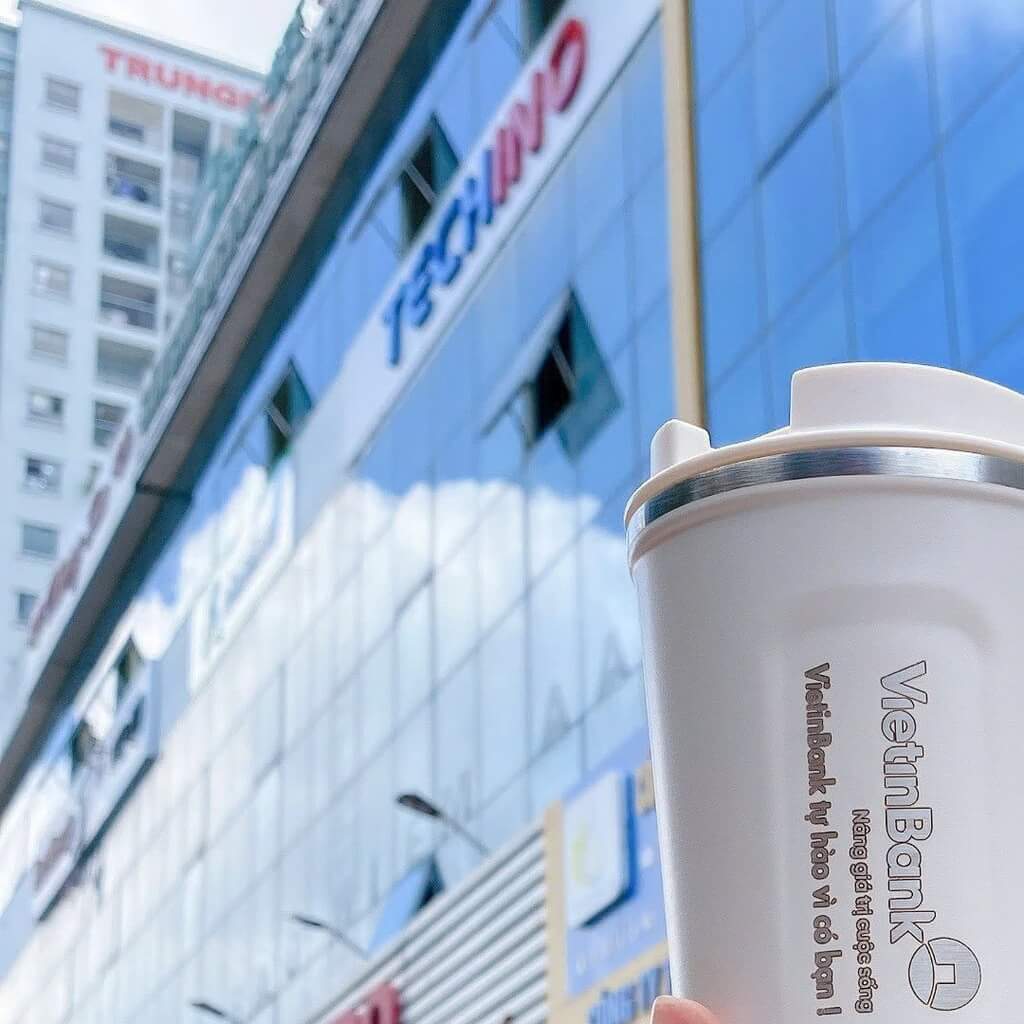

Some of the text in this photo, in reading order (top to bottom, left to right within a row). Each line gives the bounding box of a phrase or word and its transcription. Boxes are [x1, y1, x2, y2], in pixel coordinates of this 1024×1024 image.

[804, 662, 836, 796] VietinBank
[804, 800, 832, 827] tự
[880, 660, 936, 944] VietinBank
[810, 830, 838, 881] hào
[812, 885, 836, 909] vì
[850, 808, 878, 1014] Nâng giá trị cuộc sống
[812, 913, 839, 945] có
[811, 949, 842, 1000] bạn
